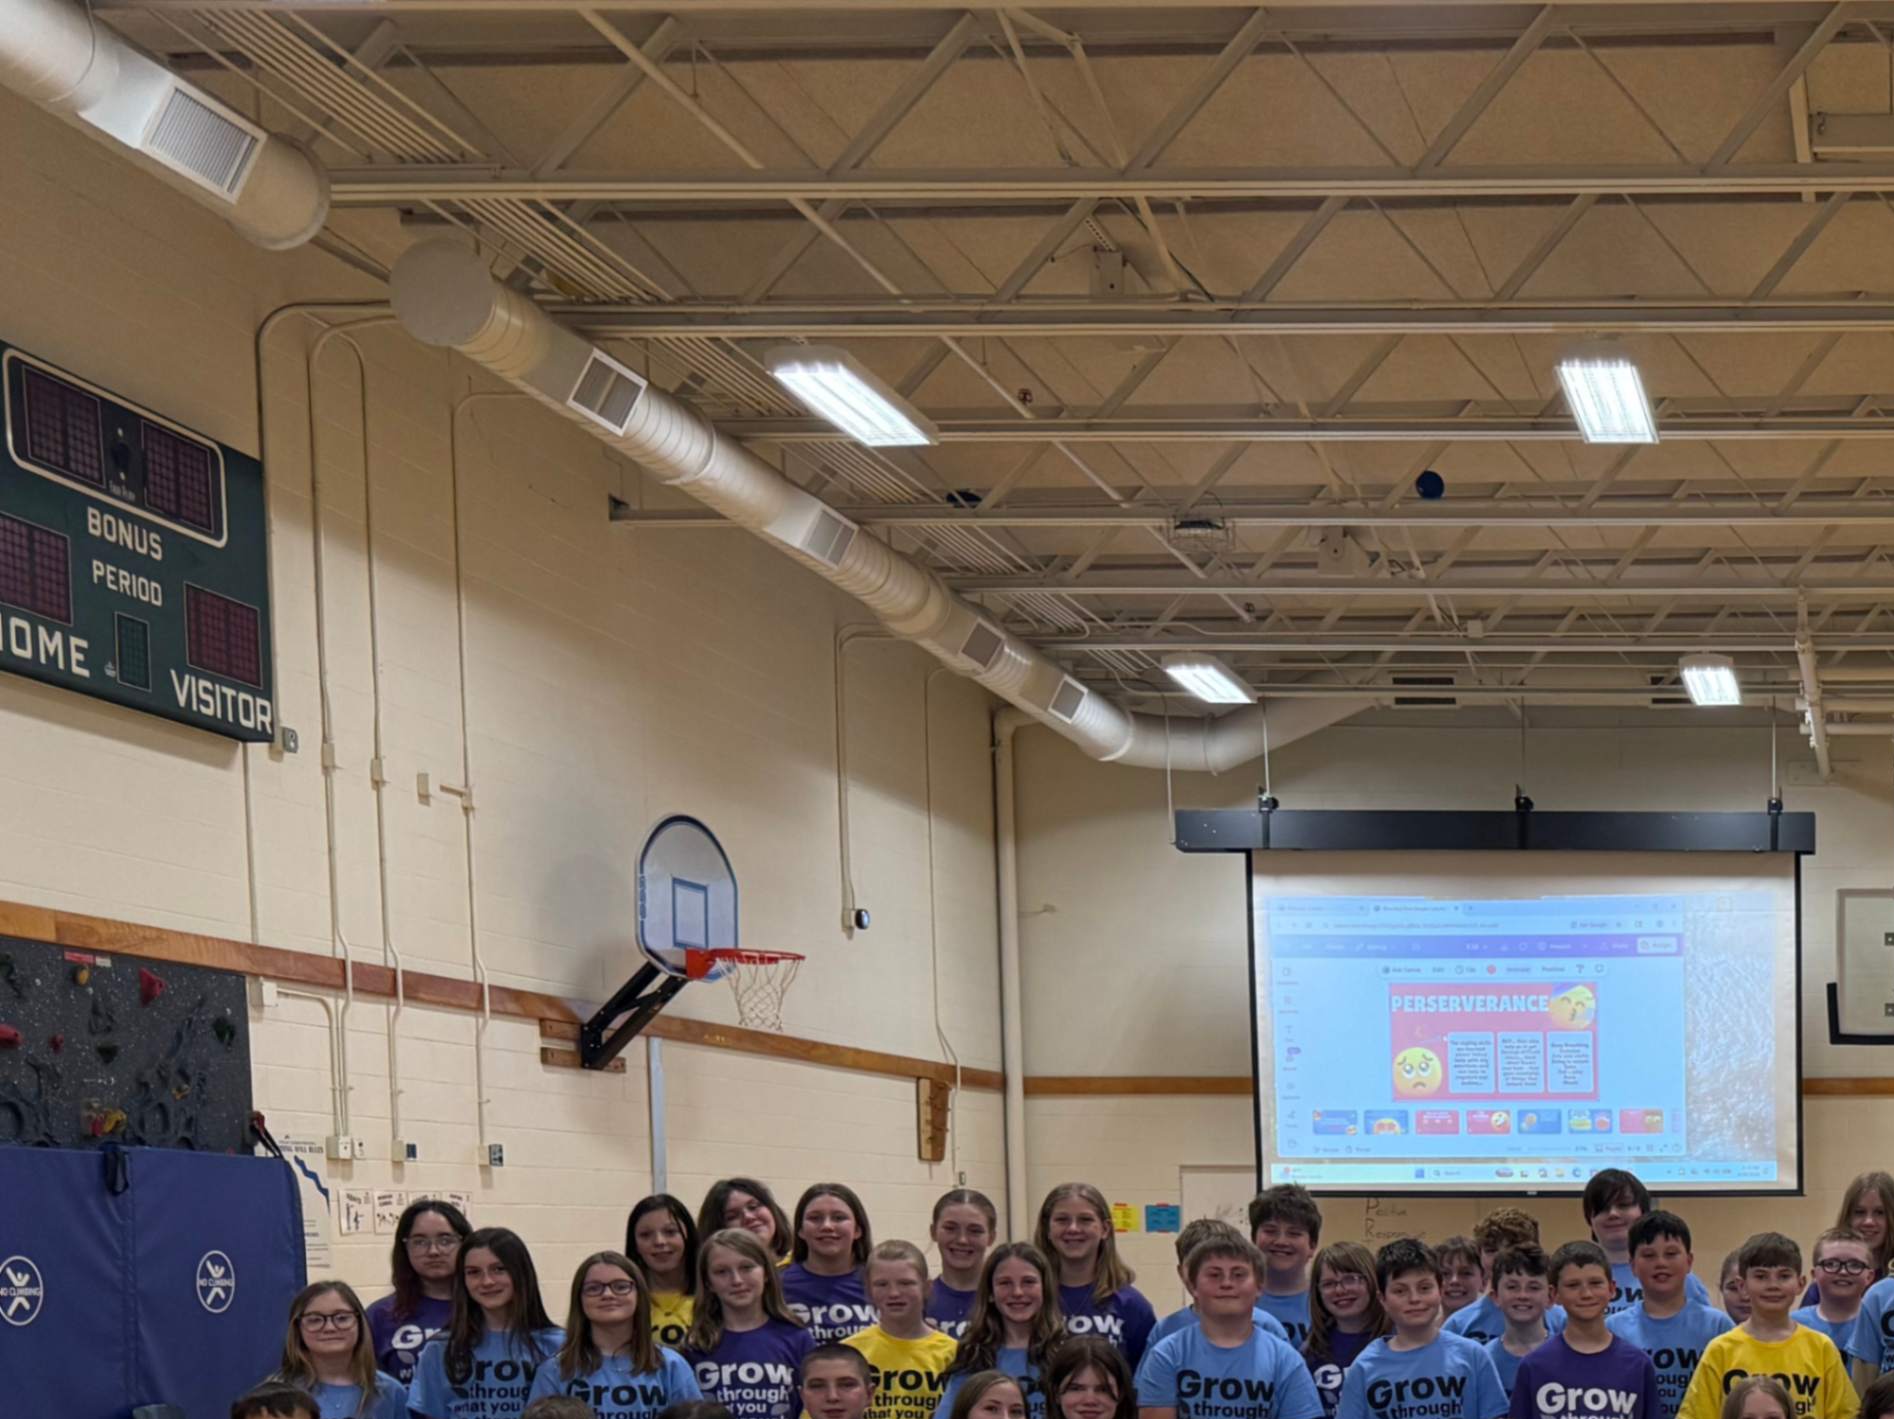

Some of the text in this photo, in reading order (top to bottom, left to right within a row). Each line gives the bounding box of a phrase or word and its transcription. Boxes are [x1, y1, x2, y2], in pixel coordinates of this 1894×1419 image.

[87, 506, 162, 560] BONUS
[93, 559, 162, 607] PERIOD
[170, 669, 272, 734] VISITOR
[1392, 995, 1549, 1013] PERSERVERANCE
[9, 1288, 40, 1296] CLIMBING
[696, 1361, 793, 1388] Grow
[1176, 1370, 1273, 1401] Grow
[717, 1386, 789, 1403] through
[1367, 1376, 1467, 1410] Grow
[1536, 1382, 1637, 1415] Grow
[486, 1402, 520, 1416] you
[737, 1403, 767, 1416] you
[1194, 1400, 1268, 1419] through
[1390, 1401, 1462, 1418] through
